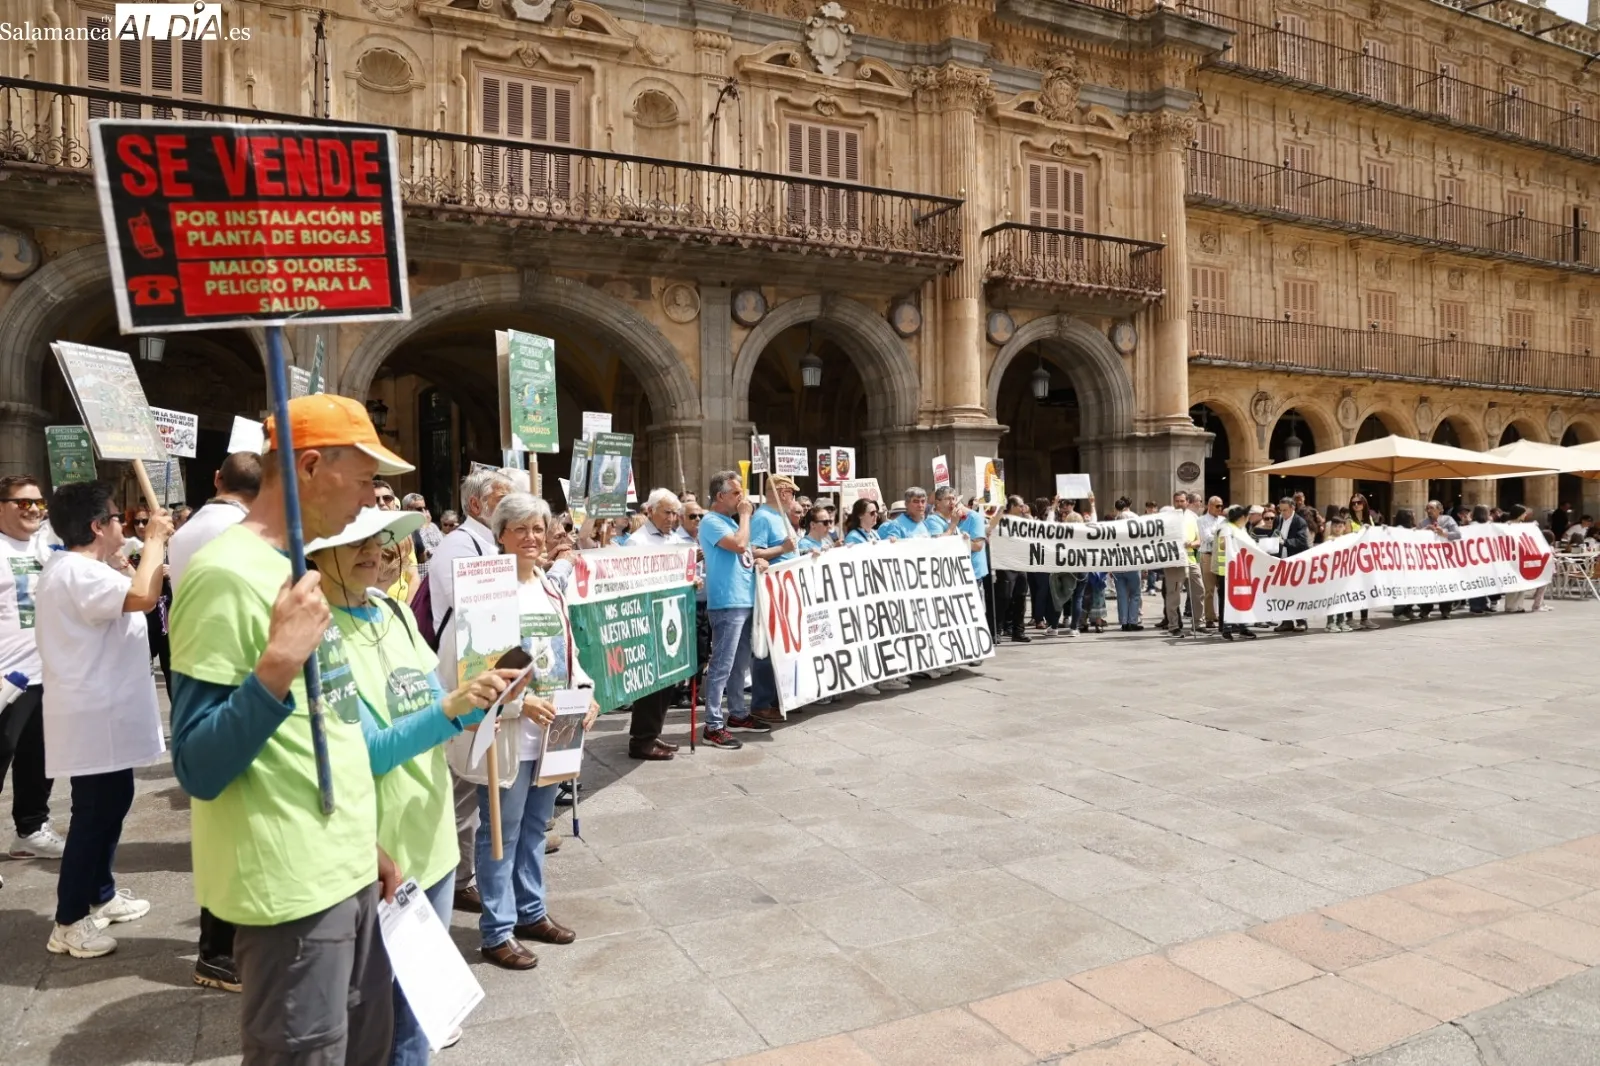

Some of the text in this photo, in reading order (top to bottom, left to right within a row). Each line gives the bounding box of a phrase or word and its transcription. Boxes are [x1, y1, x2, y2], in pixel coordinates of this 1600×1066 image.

[116, 134, 382, 197] SE VENDE
[175, 206, 383, 227] POR INSTALACIÓN DE
[187, 229, 371, 246] PLANTA DE BIOGAS
[209, 257, 363, 275] MALOS OLORES.
[204, 275, 371, 295] PELIGRO PARA LA
[259, 295, 326, 313] SALUD.
[998, 518, 1074, 540] MACHACON
[1126, 518, 1165, 540] OLOR
[458, 561, 466, 570] EL
[466, 559, 504, 569] AYUNTAMIENTO
[1307, 554, 1330, 585] ES
[460, 596, 473, 604] NOS
[473, 593, 491, 604] QUIERE
[765, 569, 802, 654] NO
[798, 567, 812, 607] A
[811, 563, 838, 605] LA
[839, 558, 906, 601] PLANTA
[904, 556, 929, 590] DE
[1266, 598, 1295, 612] STOP
[1296, 589, 1367, 610] macroplantas
[1448, 583, 1460, 592] en
[1459, 575, 1497, 591] Castilla
[604, 599, 642, 621] NOS GUSTA
[838, 592, 979, 645] EN BABILAFUENTE
[599, 619, 631, 646] NUESTRA
[606, 643, 647, 677] NO TOCAR
[813, 649, 856, 698] POR
[857, 633, 939, 683] NUESTRA
[938, 626, 993, 664] SALUD
[622, 661, 655, 694] GRACIAS
